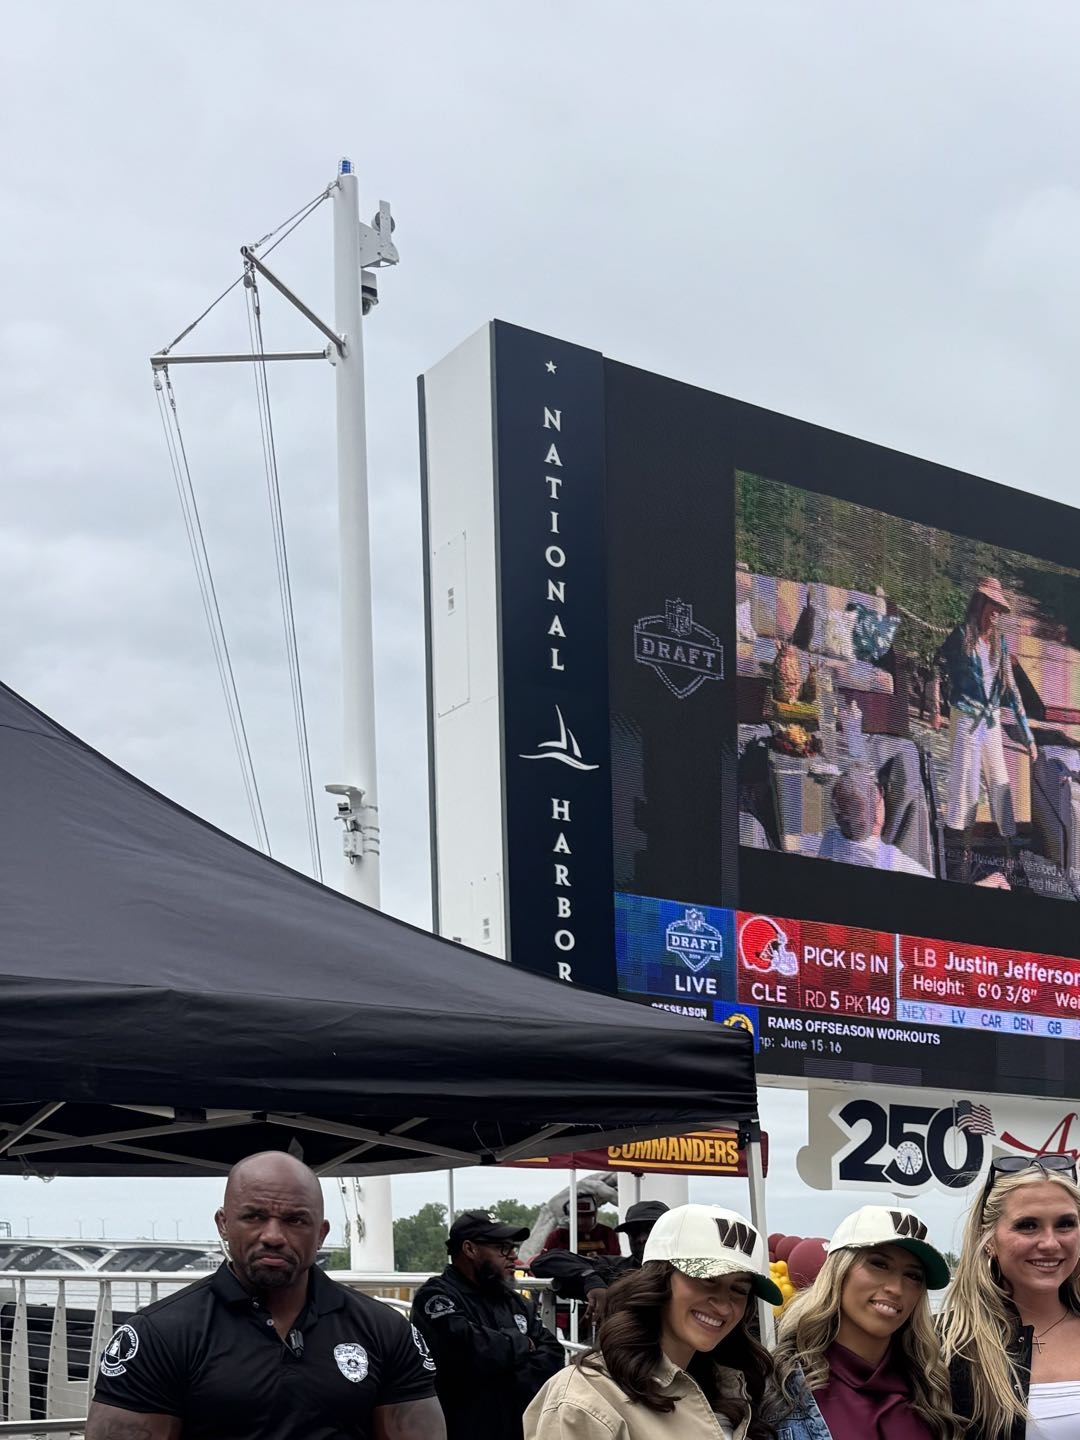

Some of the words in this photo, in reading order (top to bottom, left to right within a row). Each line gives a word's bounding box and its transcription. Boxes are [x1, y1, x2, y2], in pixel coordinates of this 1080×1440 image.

[542, 407, 566, 671] NATIONAL
[642, 638, 716, 668] DRAFT
[550, 798, 576, 982] HARBOR
[671, 935, 718, 951] DRAFT
[804, 945, 845, 968] PICK
[851, 951, 866, 971] IS
[870, 955, 888, 974] IN
[914, 948, 937, 968] LB
[944, 951, 998, 977] Justin
[675, 974, 717, 994] LIVE
[751, 982, 787, 1003] CLE
[913, 975, 965, 996] Height:
[805, 989, 826, 1008] RD
[830, 991, 840, 1010] 5
[845, 995, 864, 1014] PK
[865, 995, 890, 1015] 149
[768, 1016, 803, 1032] RAMS
[805, 1019, 875, 1038] OFFSEASON
[877, 1027, 941, 1045] WORKOUTS
[951, 1010, 966, 1024] LV
[981, 1014, 1001, 1028] CAR
[1013, 1017, 1034, 1032] DEN
[1047, 1021, 1062, 1035] GB
[780, 1037, 808, 1051] June
[608, 1137, 739, 1165] COMMANDERS
[839, 1099, 985, 1189] 250
